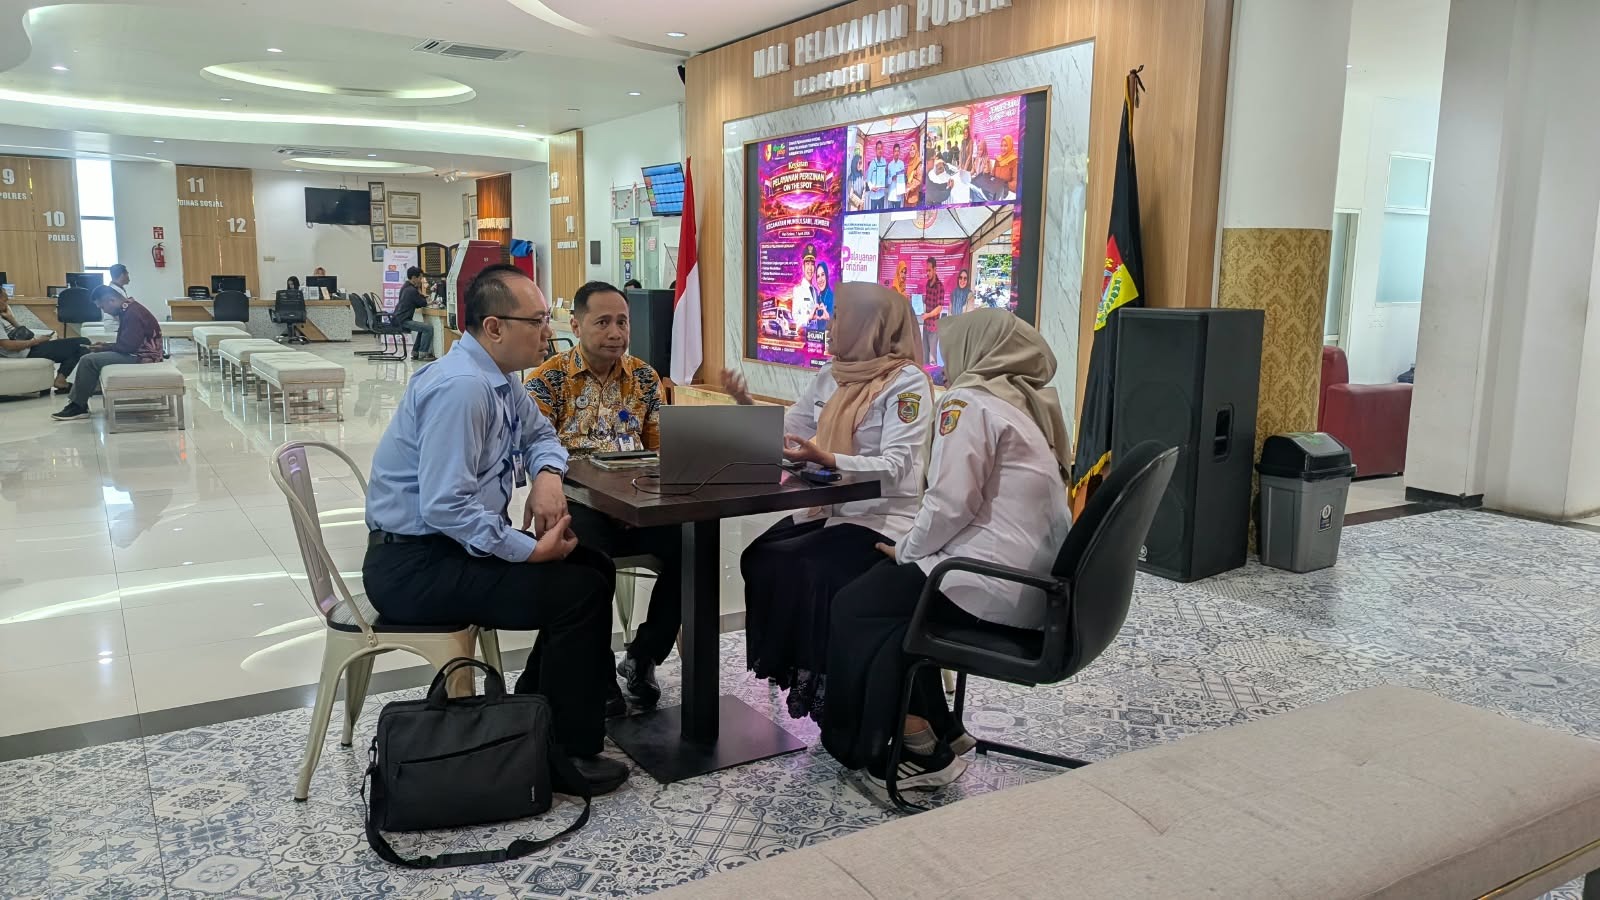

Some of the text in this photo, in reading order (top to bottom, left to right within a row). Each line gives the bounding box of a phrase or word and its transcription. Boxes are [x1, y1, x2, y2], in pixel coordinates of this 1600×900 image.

[795, 3, 908, 66] PELAYANAN
[916, 0, 1012, 32] PUBL
[2, 168, 15, 185] 9
[187, 177, 205, 193] 11
[43, 211, 65, 227] 10
[227, 217, 247, 233] 12
[48, 234, 76, 242] POLRES
